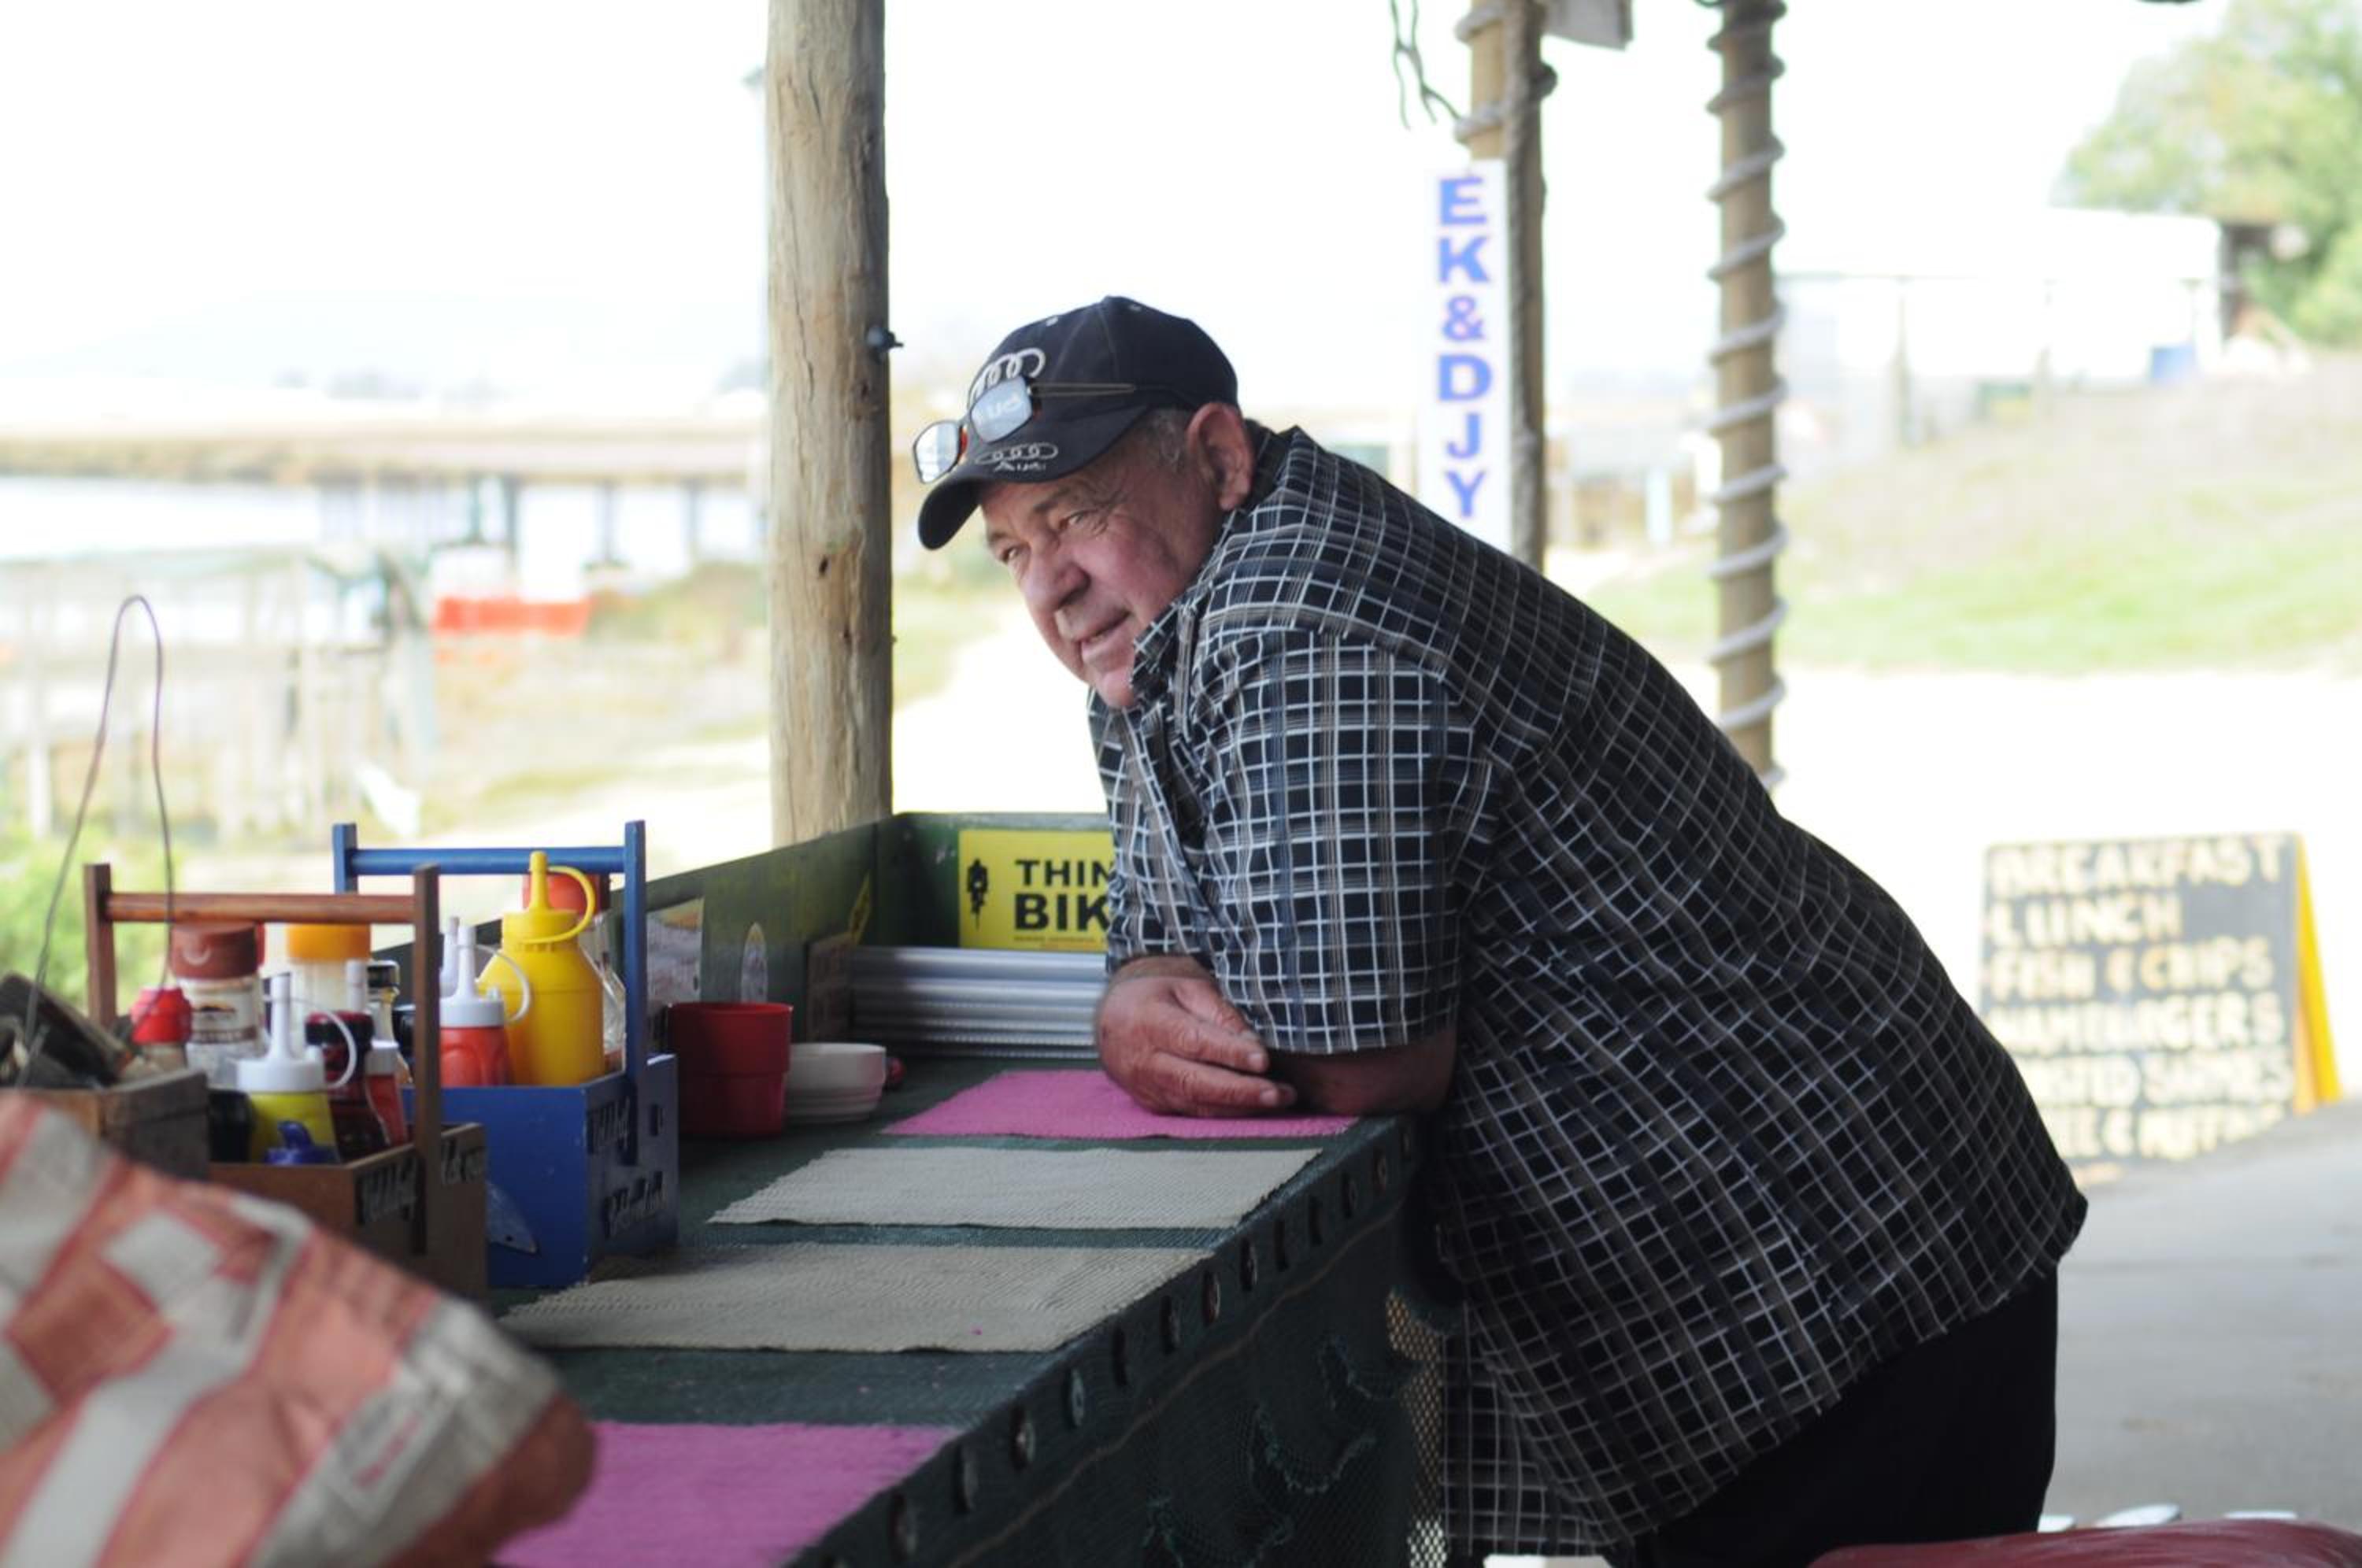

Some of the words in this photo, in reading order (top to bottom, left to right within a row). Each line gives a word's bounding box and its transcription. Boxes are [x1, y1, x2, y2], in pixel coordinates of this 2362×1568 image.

[1015, 859, 1114, 888] THIN
[1988, 833, 2284, 899] BREAKFAST
[1014, 893, 1112, 931] BIK
[1990, 893, 2182, 947] LUNCH
[1990, 947, 2095, 1000] FISH
[2139, 935, 2274, 990] CHIPS
